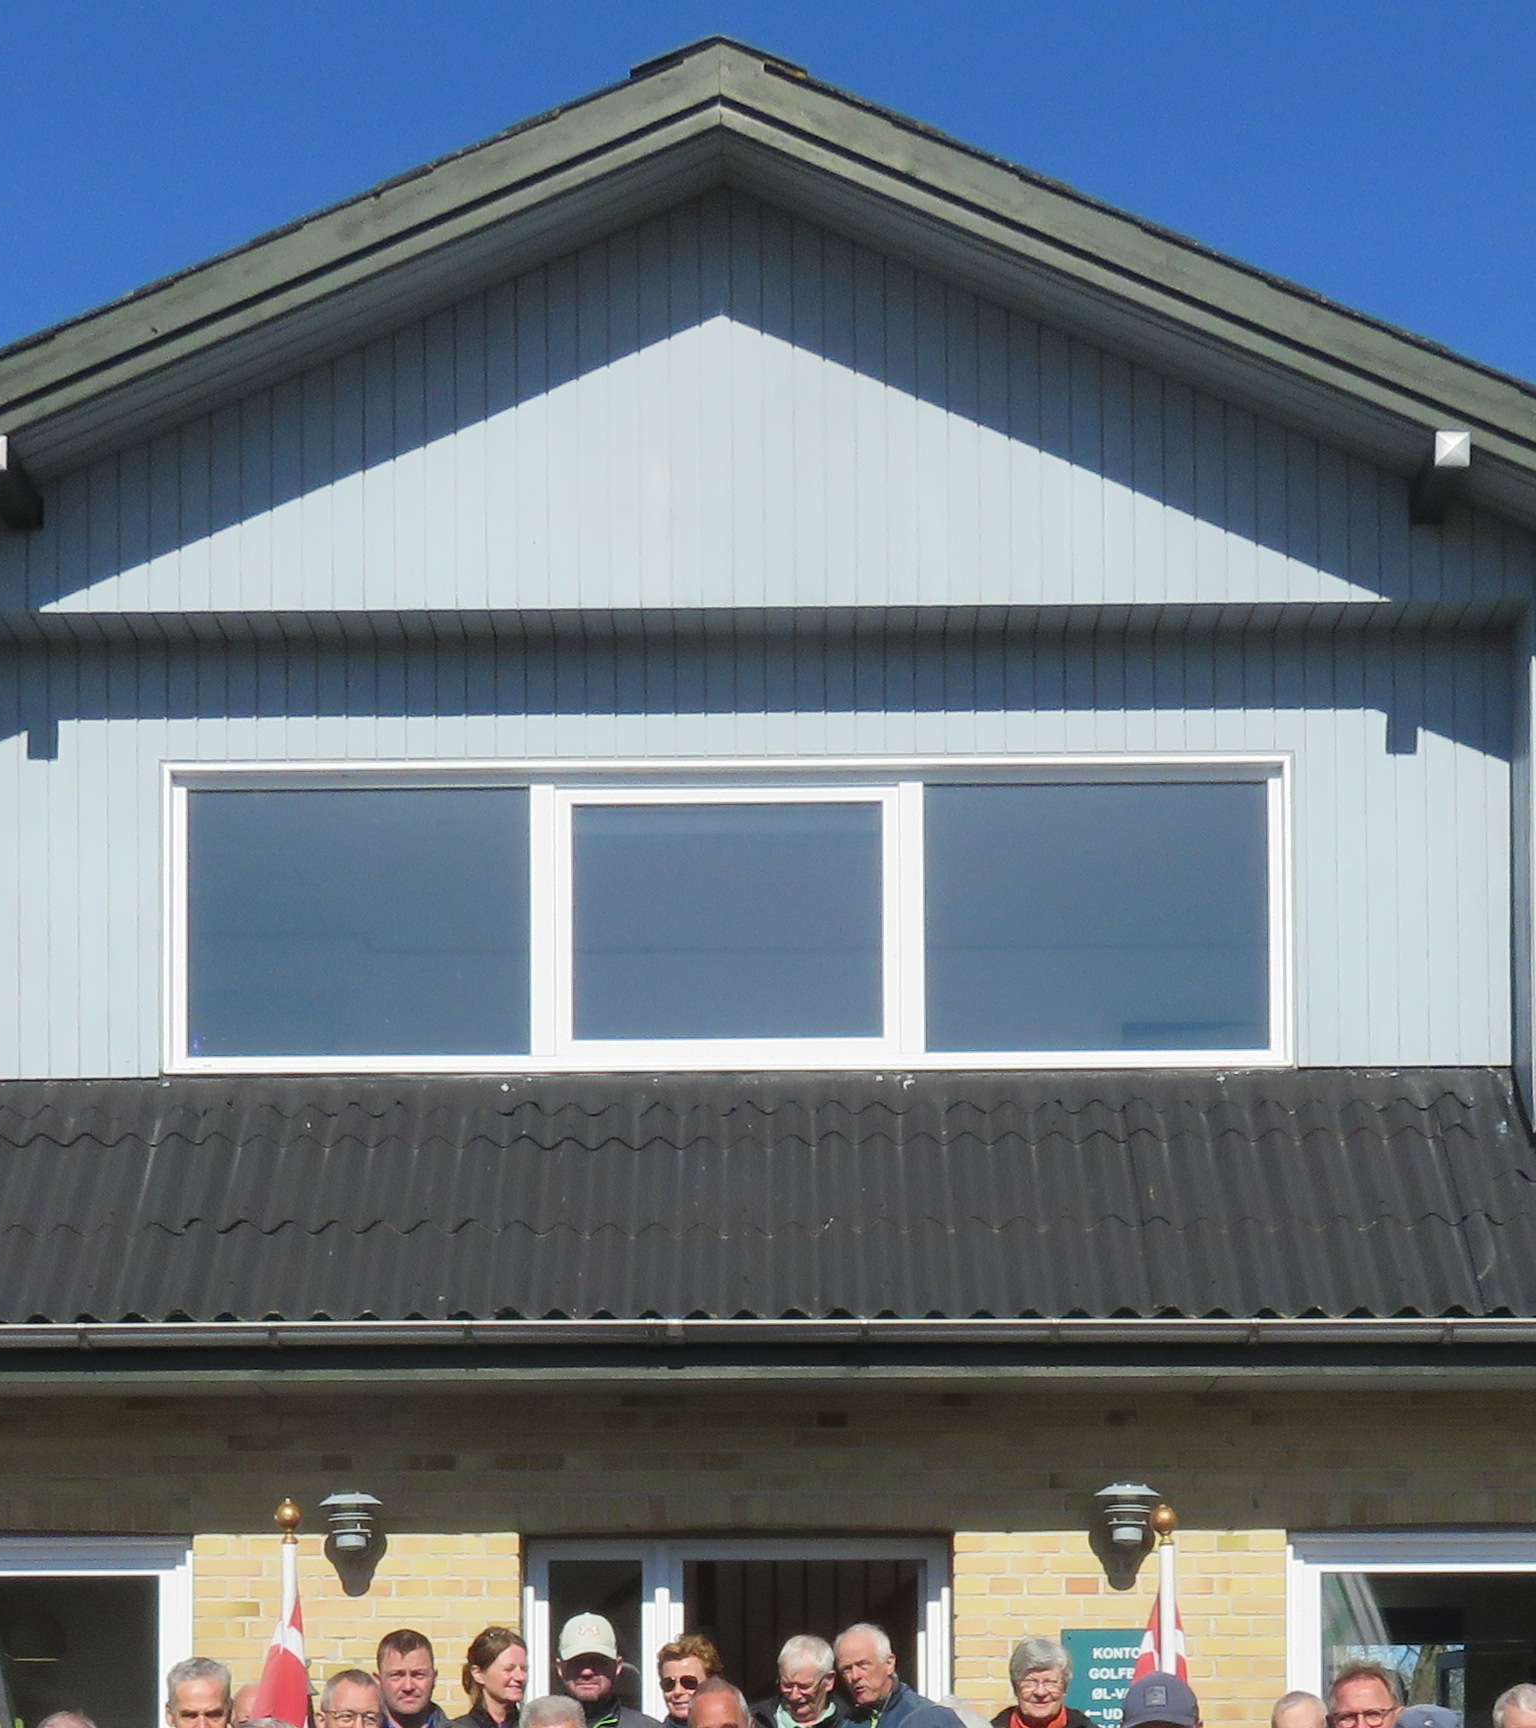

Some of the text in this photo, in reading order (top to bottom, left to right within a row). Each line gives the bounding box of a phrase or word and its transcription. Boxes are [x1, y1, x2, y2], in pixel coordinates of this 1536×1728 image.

[1092, 1648, 1140, 1660] KONTO
[1088, 1668, 1135, 1680] GOLFB
[1092, 1688, 1130, 1700] ØL-V
[1102, 1708, 1124, 1720] UD
